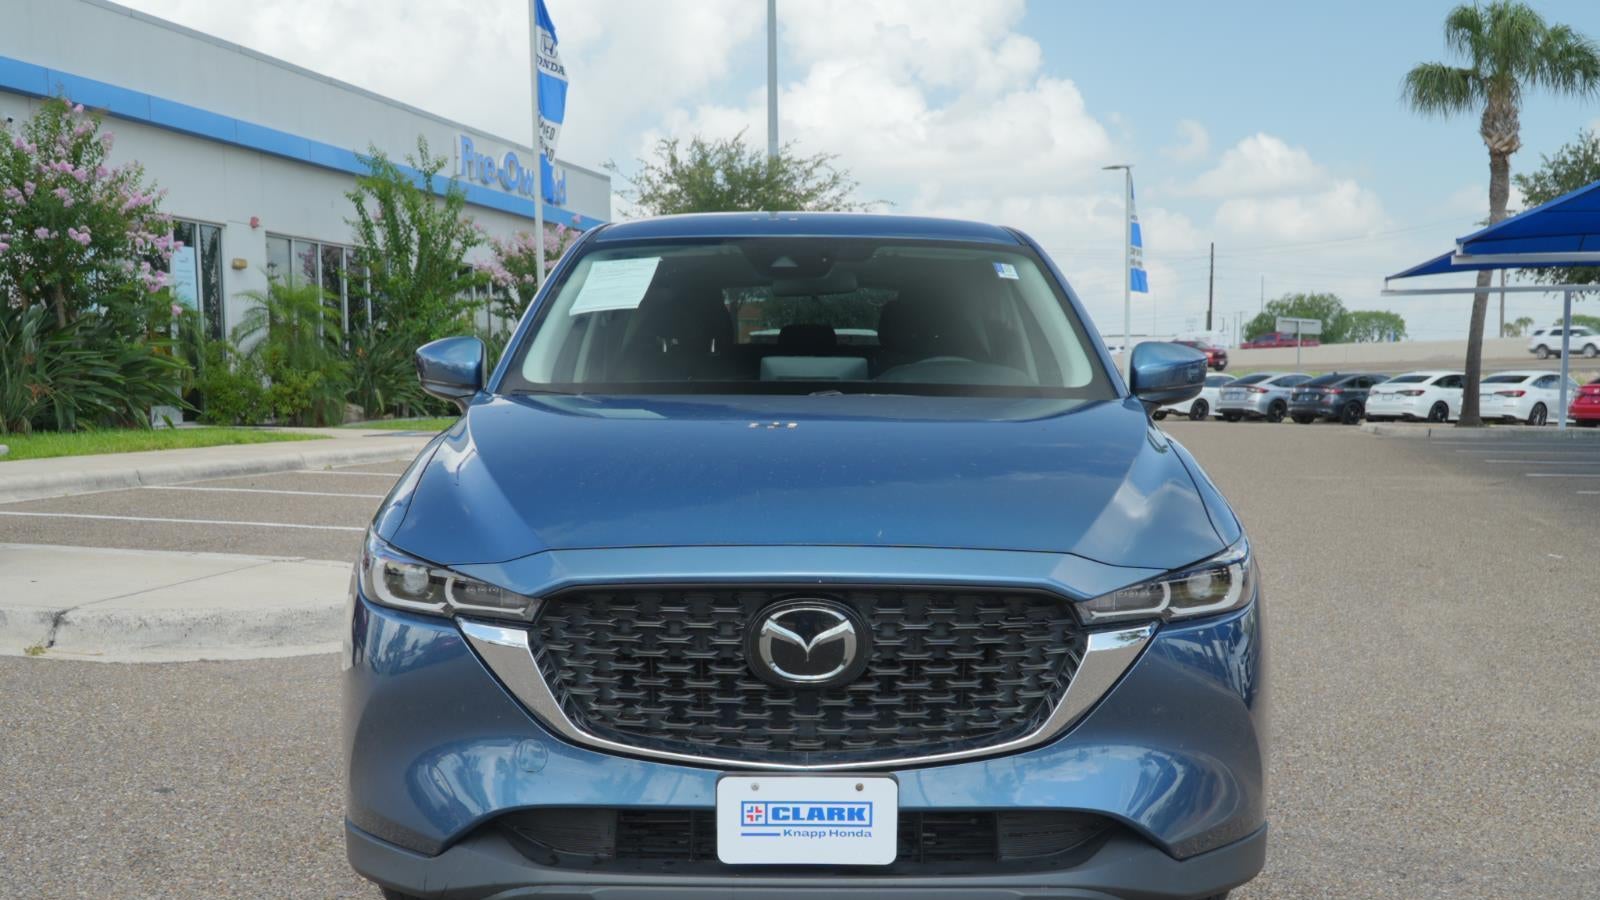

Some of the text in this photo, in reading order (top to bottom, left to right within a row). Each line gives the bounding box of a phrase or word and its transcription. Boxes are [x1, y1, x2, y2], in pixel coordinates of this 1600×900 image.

[536, 54, 565, 76] ONDA
[460, 133, 567, 206] Pre-Owd
[771, 806, 866, 822] CLARK
[783, 829, 873, 839] Knapp Honda
